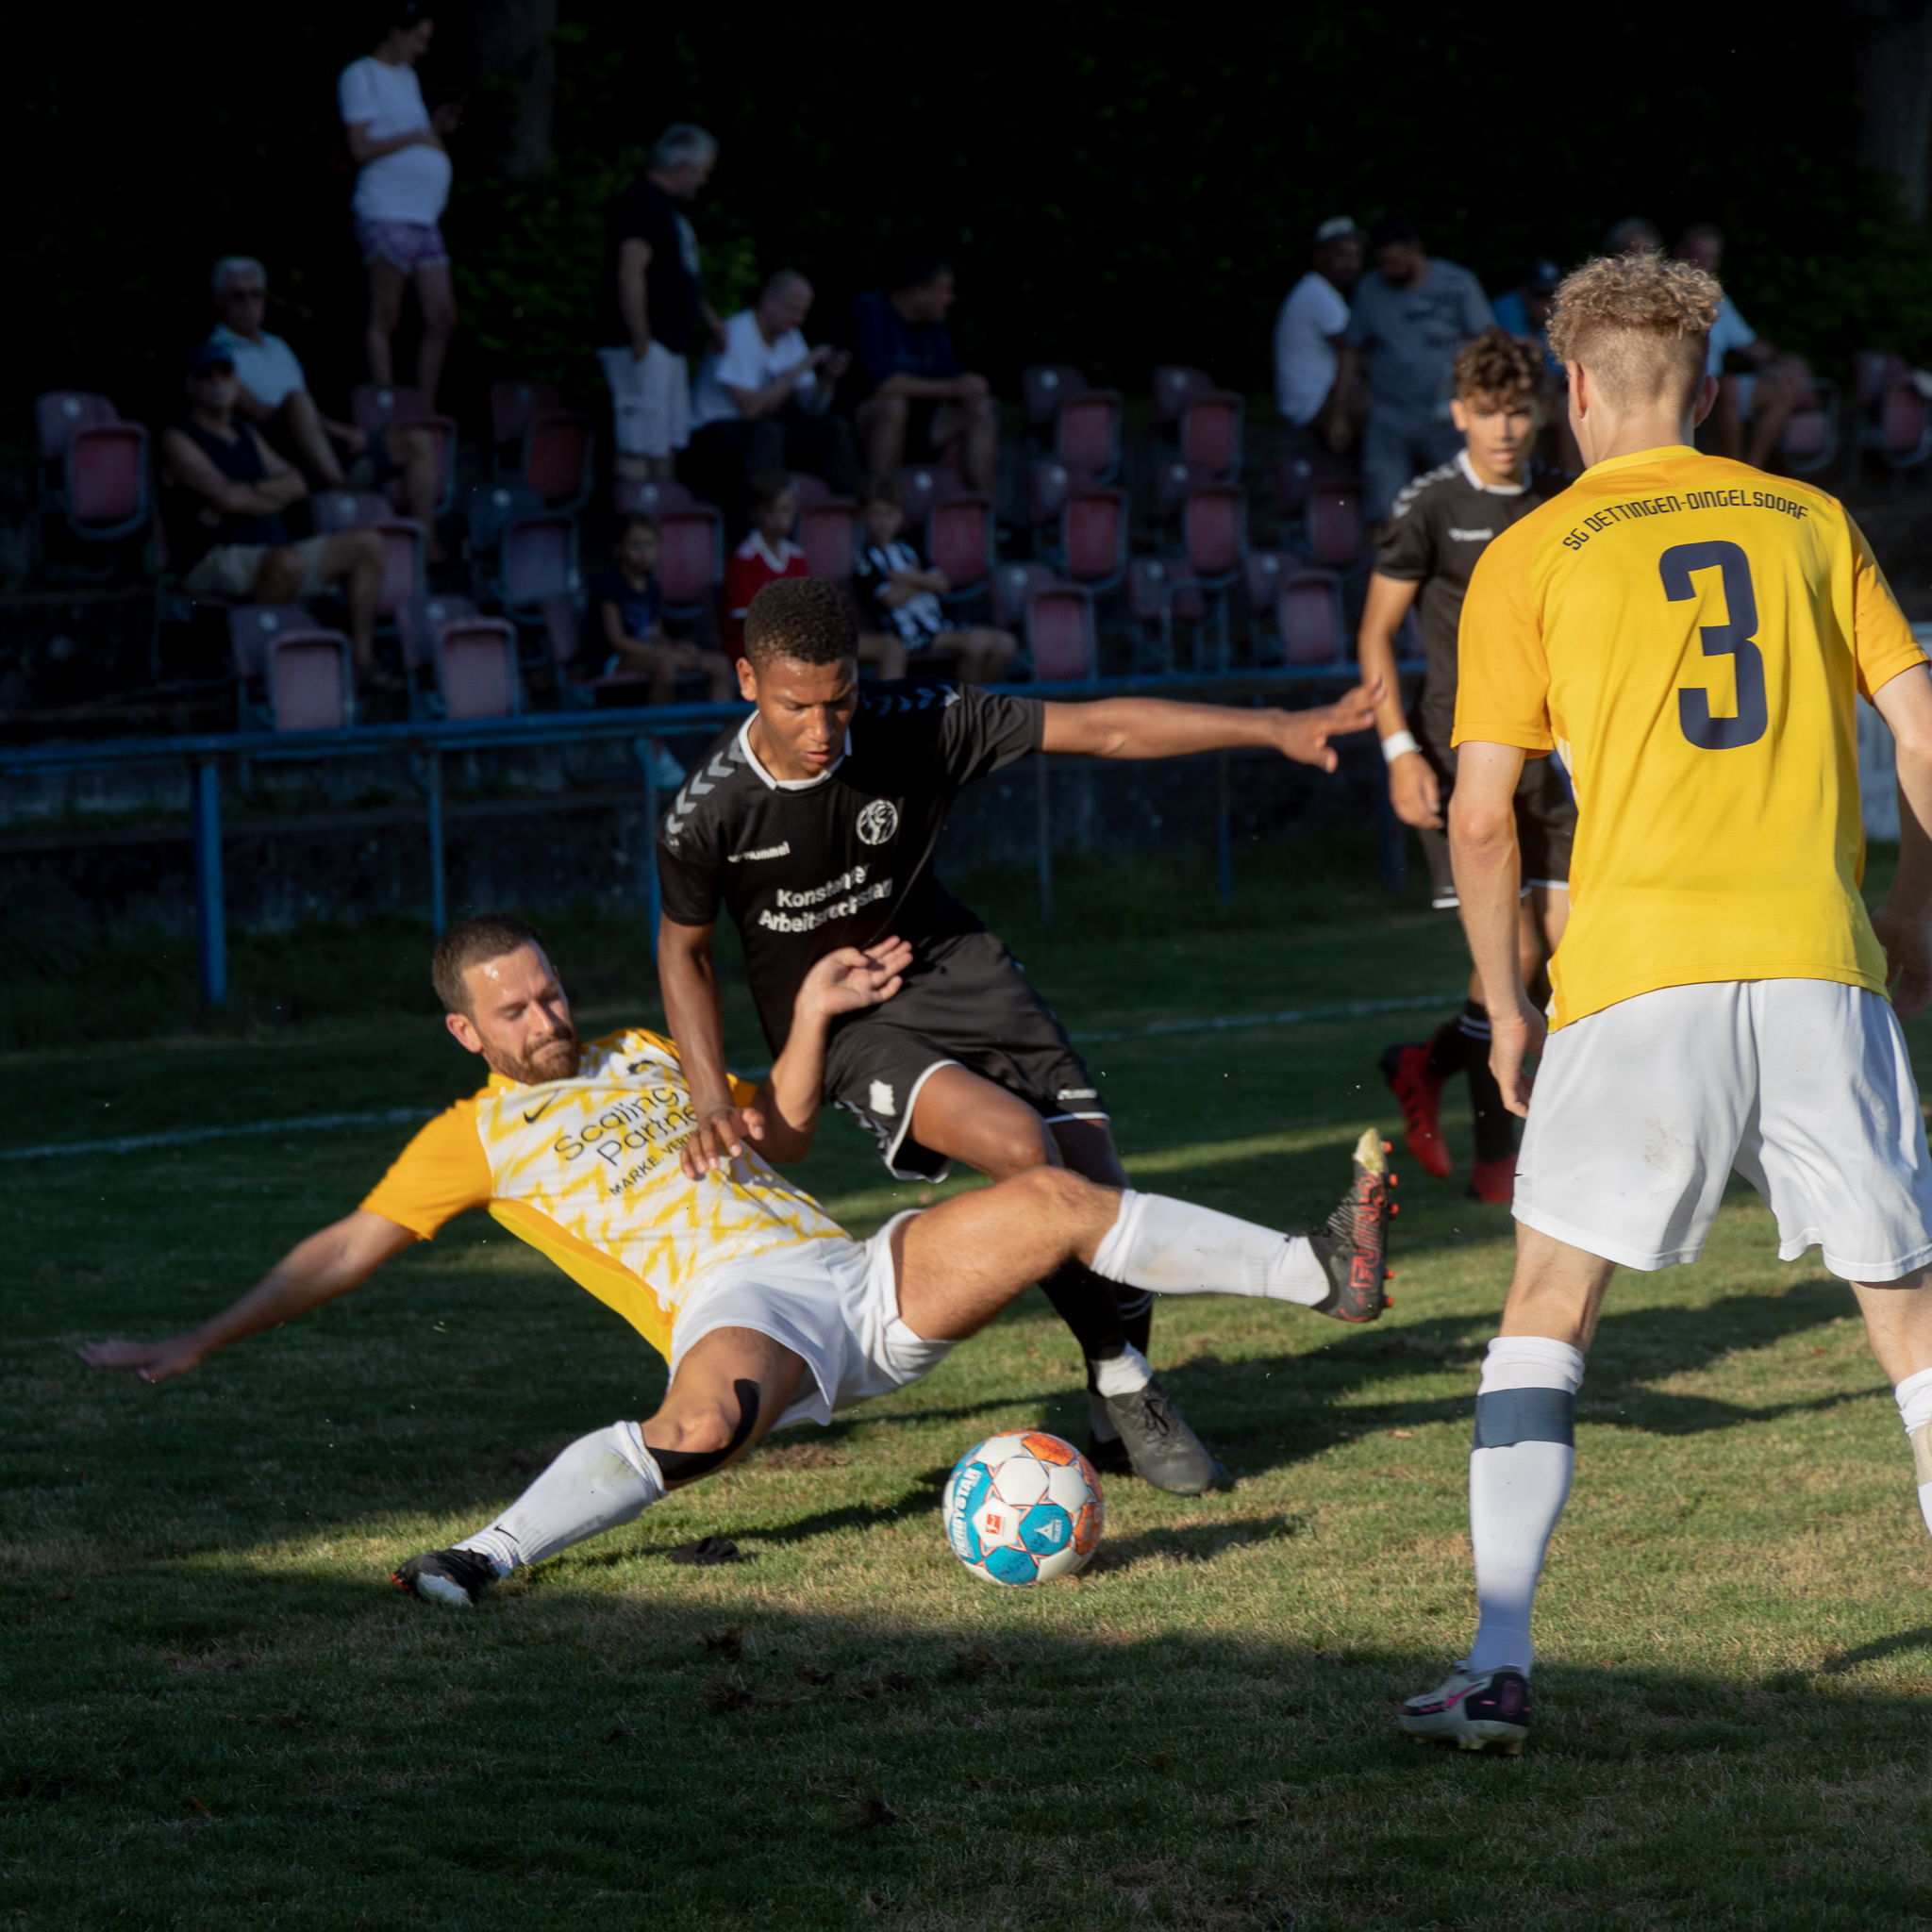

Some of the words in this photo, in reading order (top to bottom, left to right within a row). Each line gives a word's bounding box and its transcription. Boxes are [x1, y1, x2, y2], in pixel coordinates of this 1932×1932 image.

[1562, 528, 1590, 551] SG
[1583, 490, 1808, 532] DETTINGEN-DINGELSDORF
[1658, 540, 1769, 750] 3
[554, 1088, 680, 1161] Scaling
[596, 1105, 699, 1167] Partne
[952, 1467, 980, 1557] DERBYSTAR
